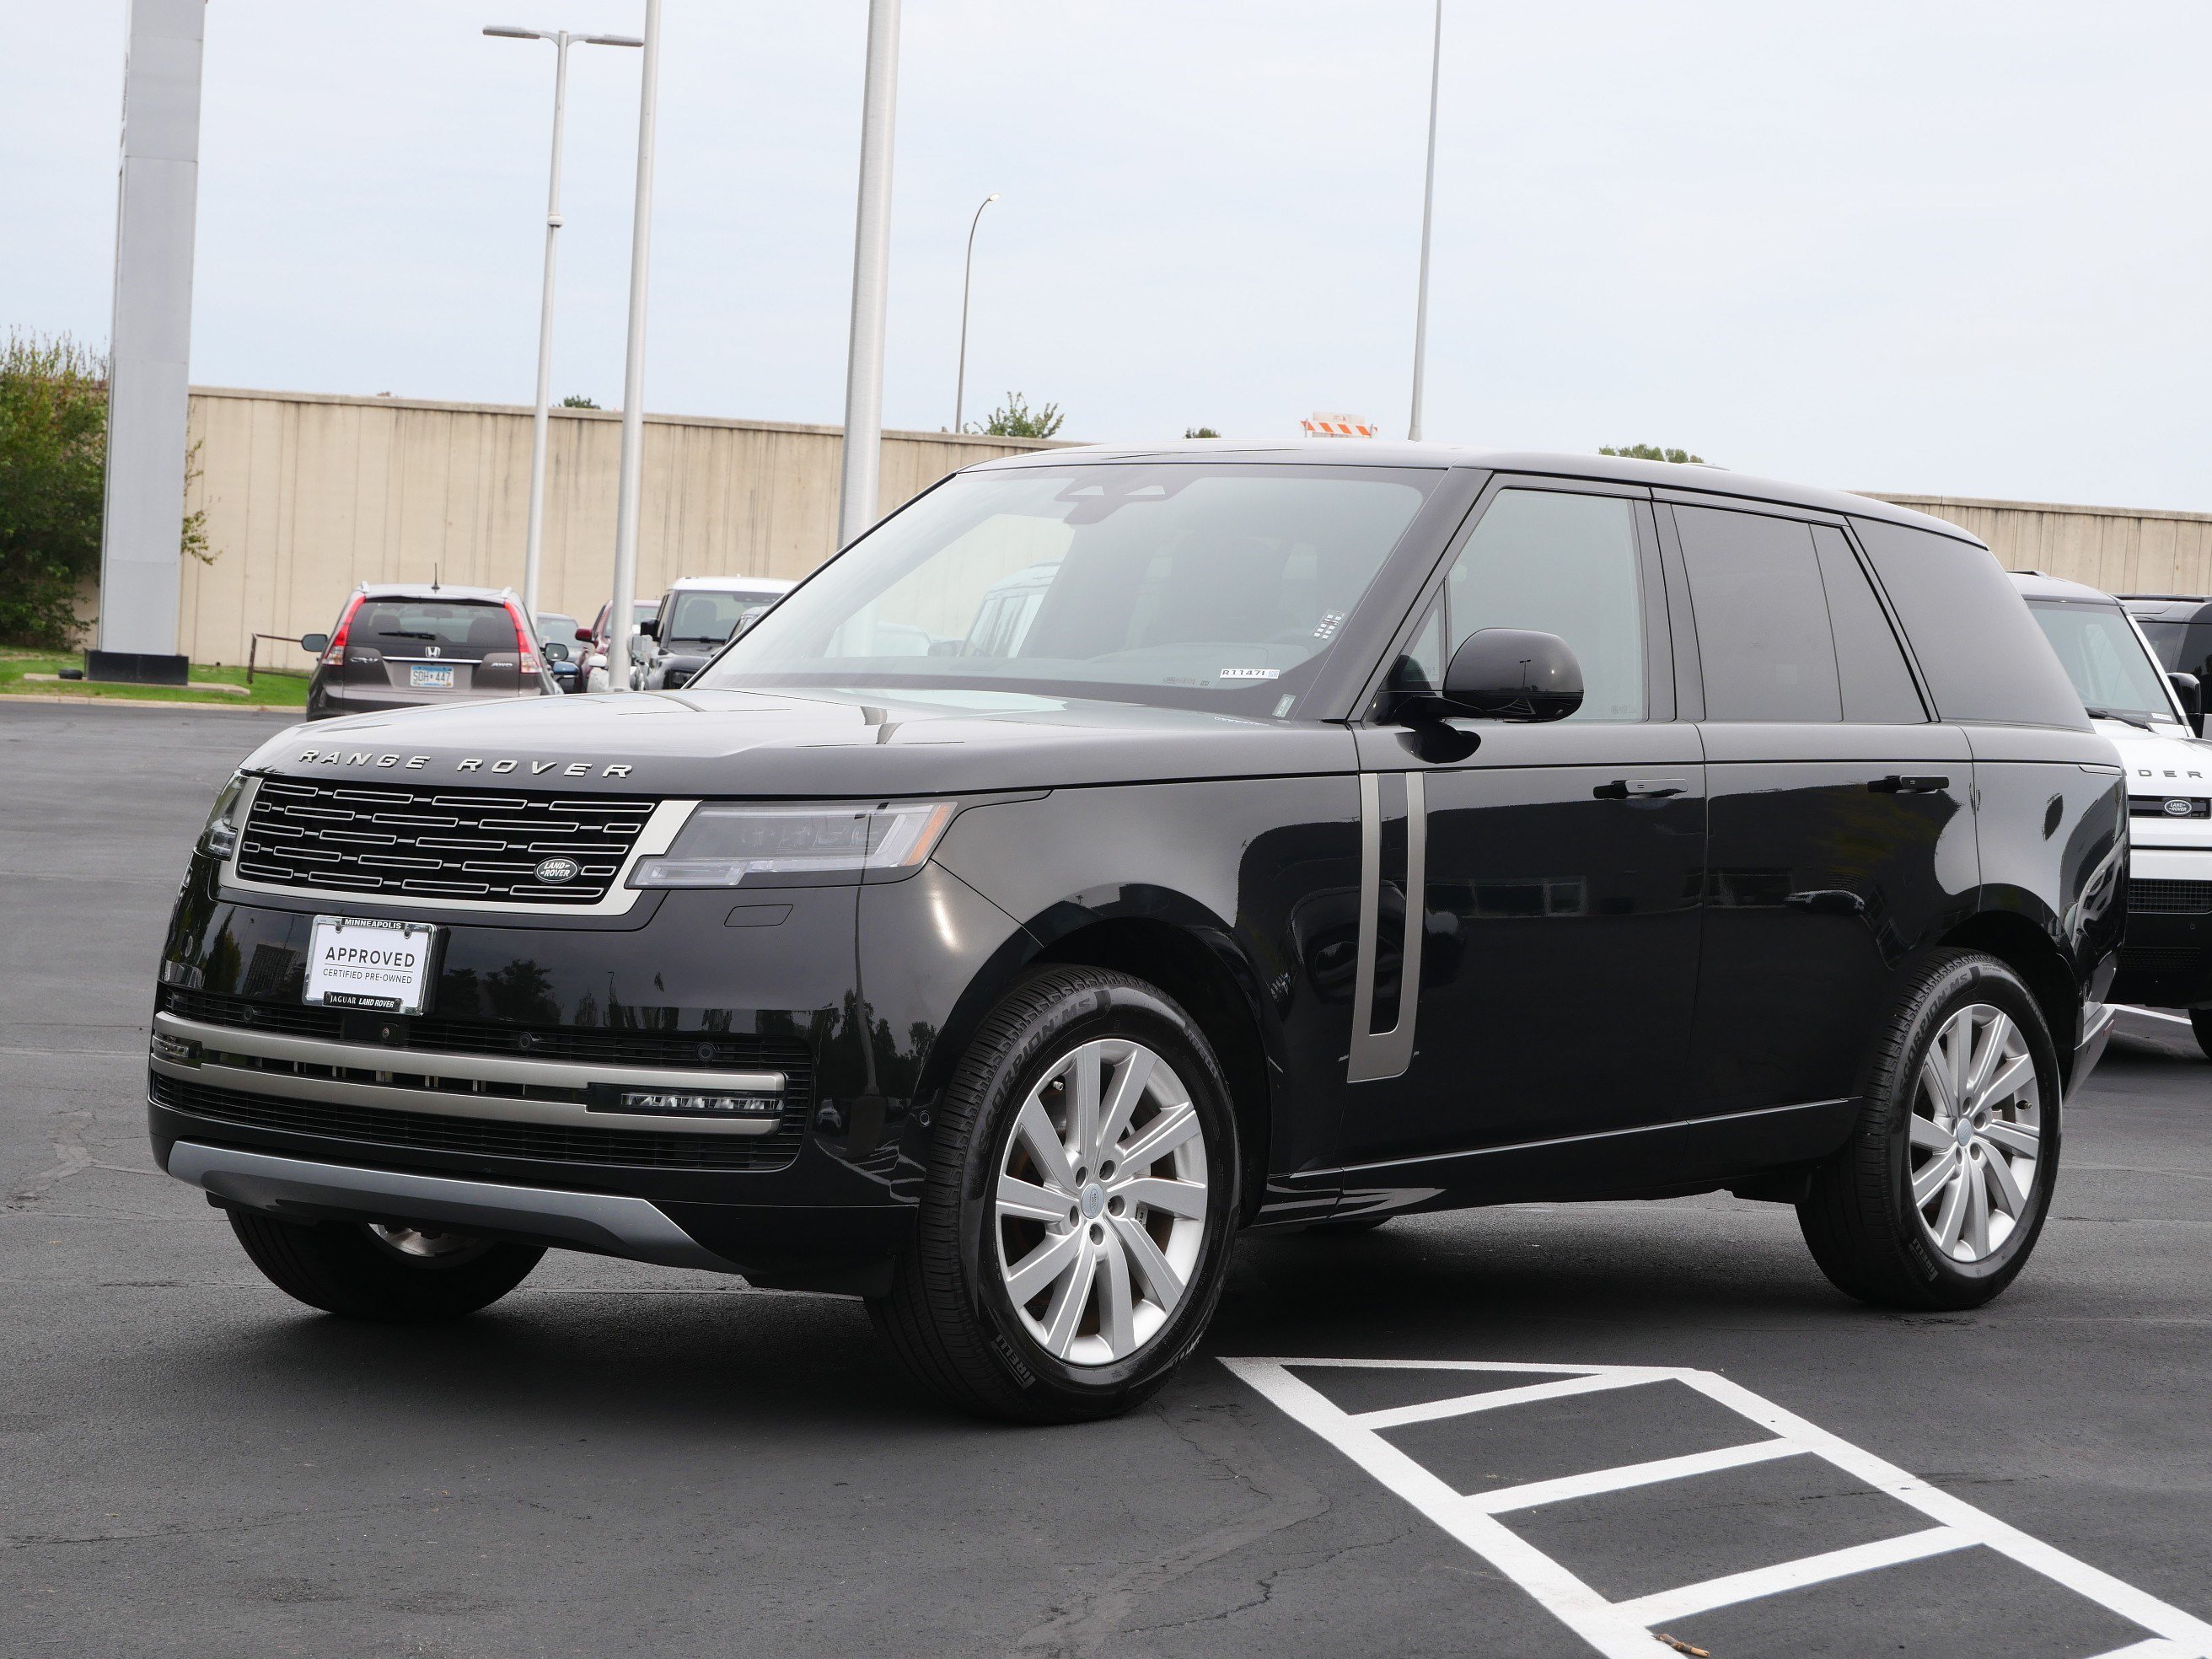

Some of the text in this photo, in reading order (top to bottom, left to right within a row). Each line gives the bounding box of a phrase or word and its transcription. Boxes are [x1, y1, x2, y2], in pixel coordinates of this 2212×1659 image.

[298, 749, 633, 779] RANGE ROVER
[344, 919, 402, 929] MINNEAPOLIS
[325, 947, 415, 967] APPROVED
[323, 969, 412, 984] CERTIFIED PRE-OWNED
[330, 995, 395, 1007] JAGUAR LAND ROVER
[979, 1018, 1055, 1153] SCORPION
[991, 1334, 1037, 1389] PIRELLI
